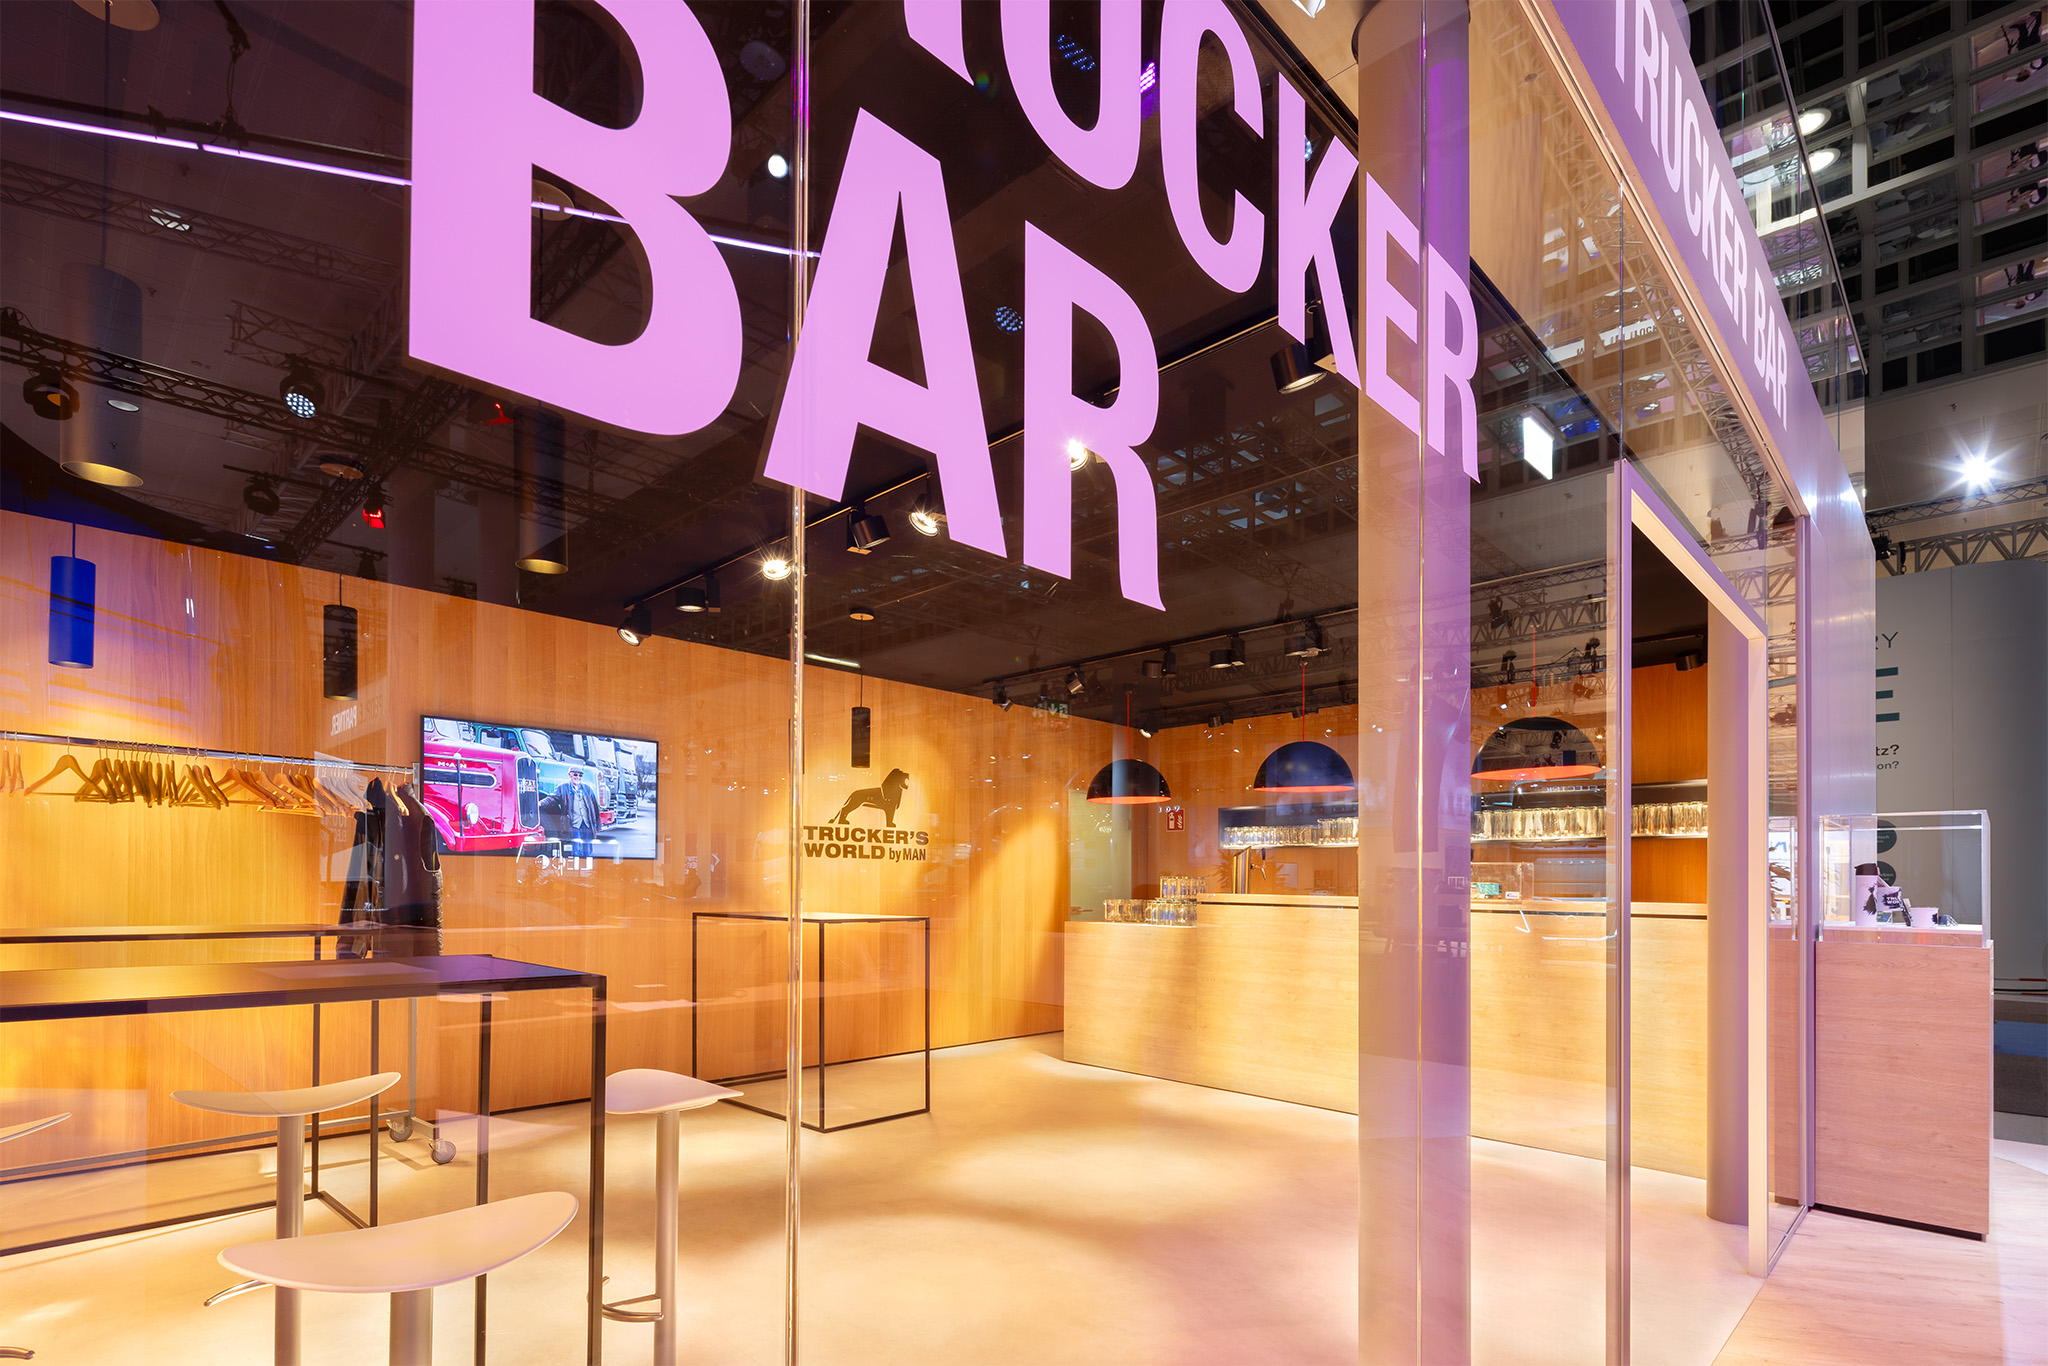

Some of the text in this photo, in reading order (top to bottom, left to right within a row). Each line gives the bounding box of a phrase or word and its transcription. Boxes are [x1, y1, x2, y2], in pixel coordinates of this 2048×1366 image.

[409, 0, 1165, 611] BAR
[905, 0, 1479, 483] UCKER
[1753, 266, 1788, 431] BAR
[803, 825, 929, 846] TRUCKER'S
[804, 843, 926, 863] WORLD by MAN
